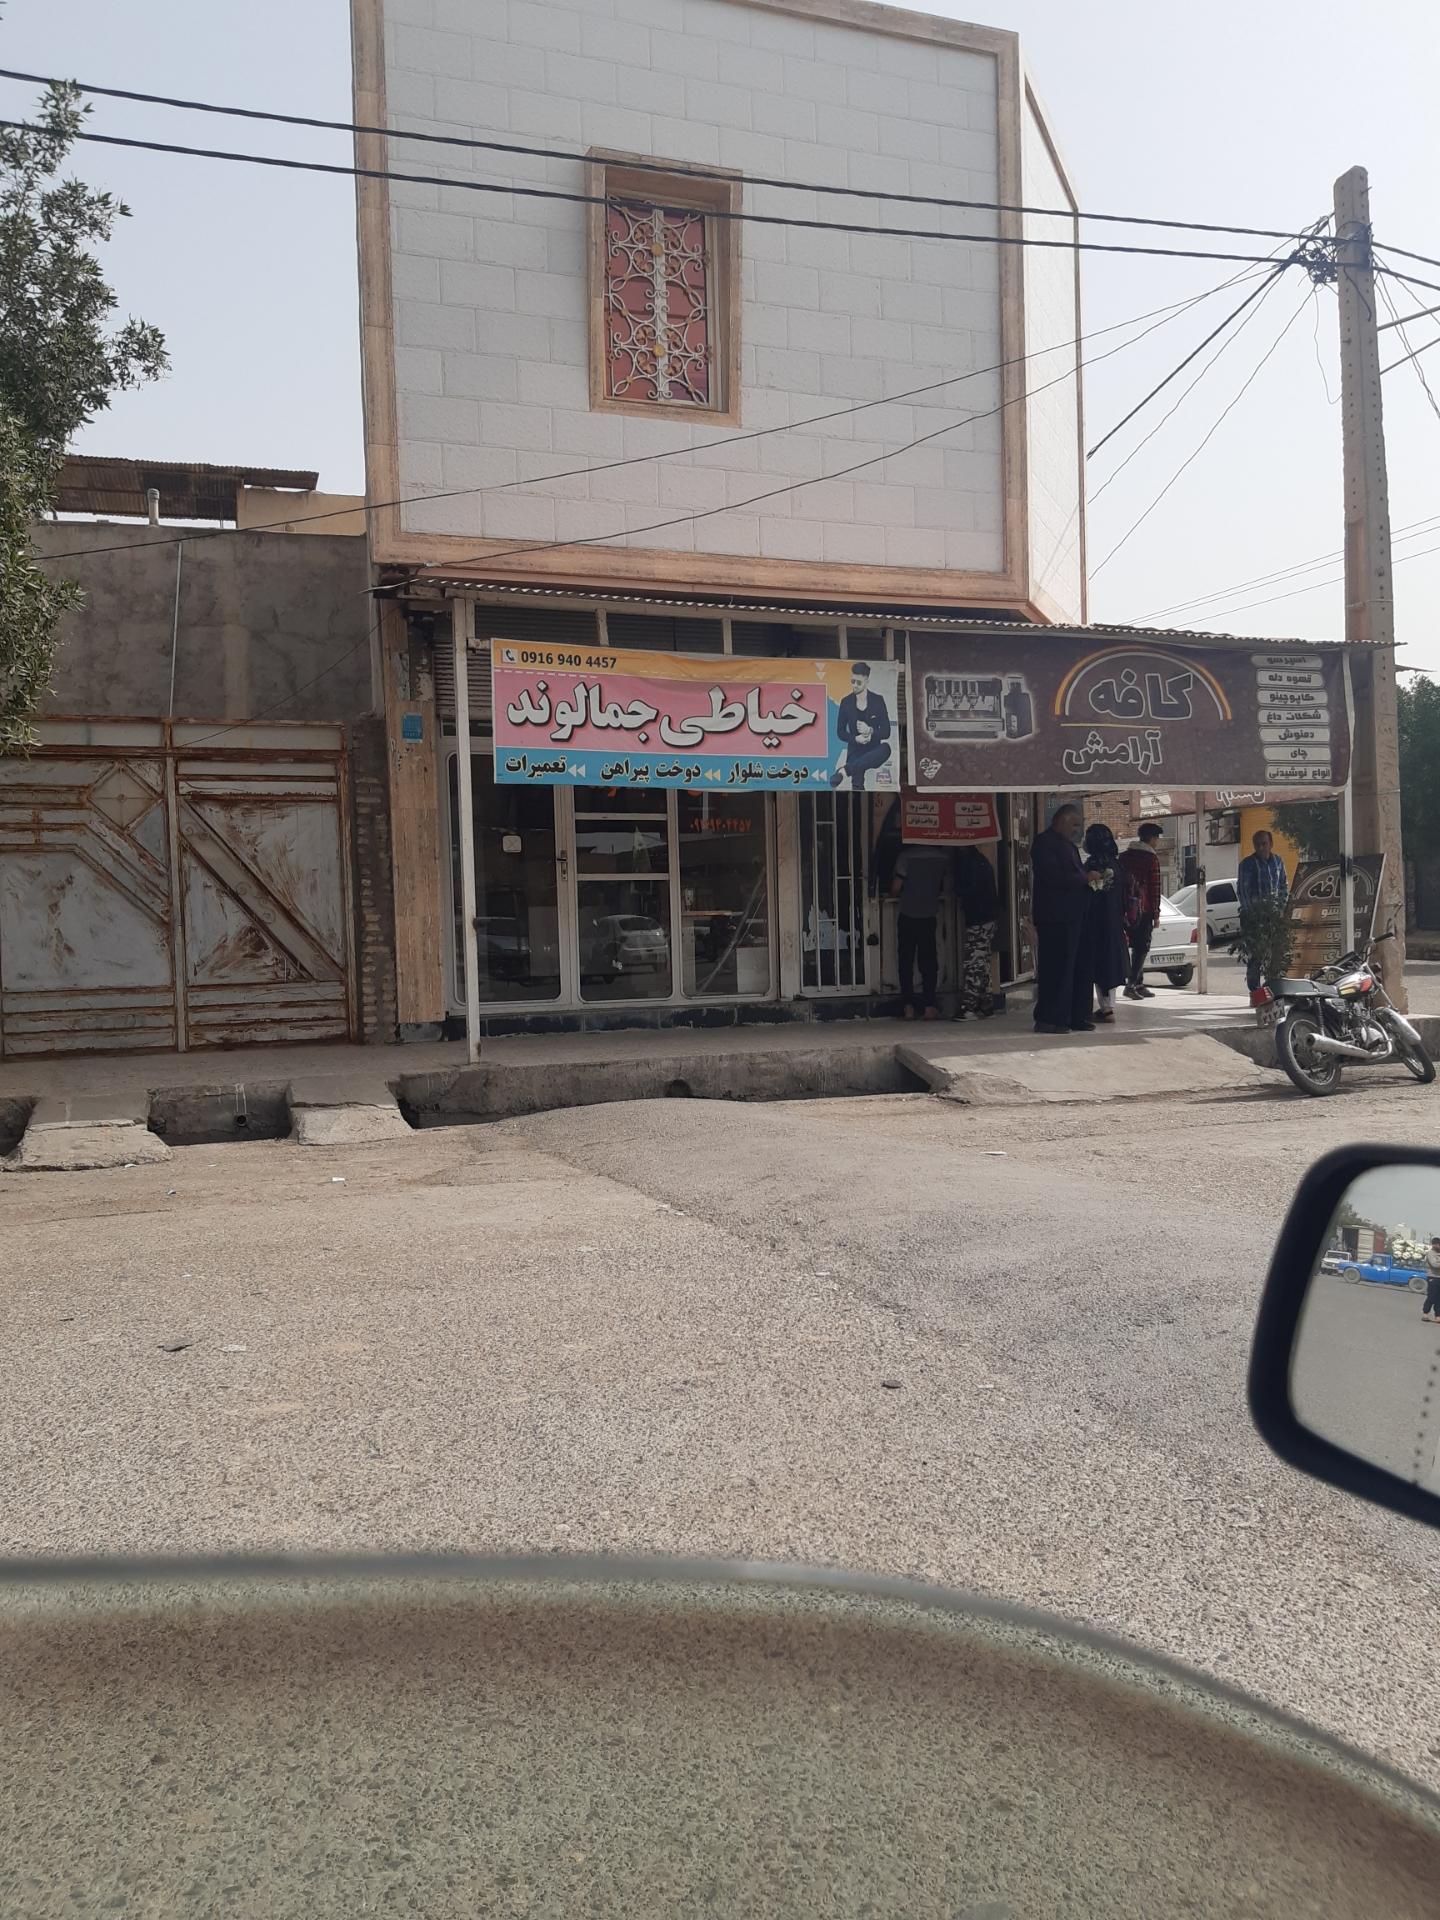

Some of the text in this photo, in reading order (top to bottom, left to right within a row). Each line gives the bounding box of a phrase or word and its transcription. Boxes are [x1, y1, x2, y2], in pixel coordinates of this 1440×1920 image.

[521, 651, 617, 669] 0916 940 4457
[1089, 668, 1193, 720] کافه
[1269, 692, 1315, 705] کاپوچینو
[507, 680, 817, 749] خیاطی جمالوند
[1267, 709, 1321, 723] شکلات داغ
[1278, 728, 1315, 740] دمنوش
[1063, 730, 1162, 775] آرامش
[1290, 748, 1308, 760] چای
[505, 754, 567, 778] تعمیرات
[601, 758, 701, 784] دوخت پیراهن
[727, 761, 809, 784] دوخت شلوار
[1269, 766, 1330, 781] انواع نوشیدنی
